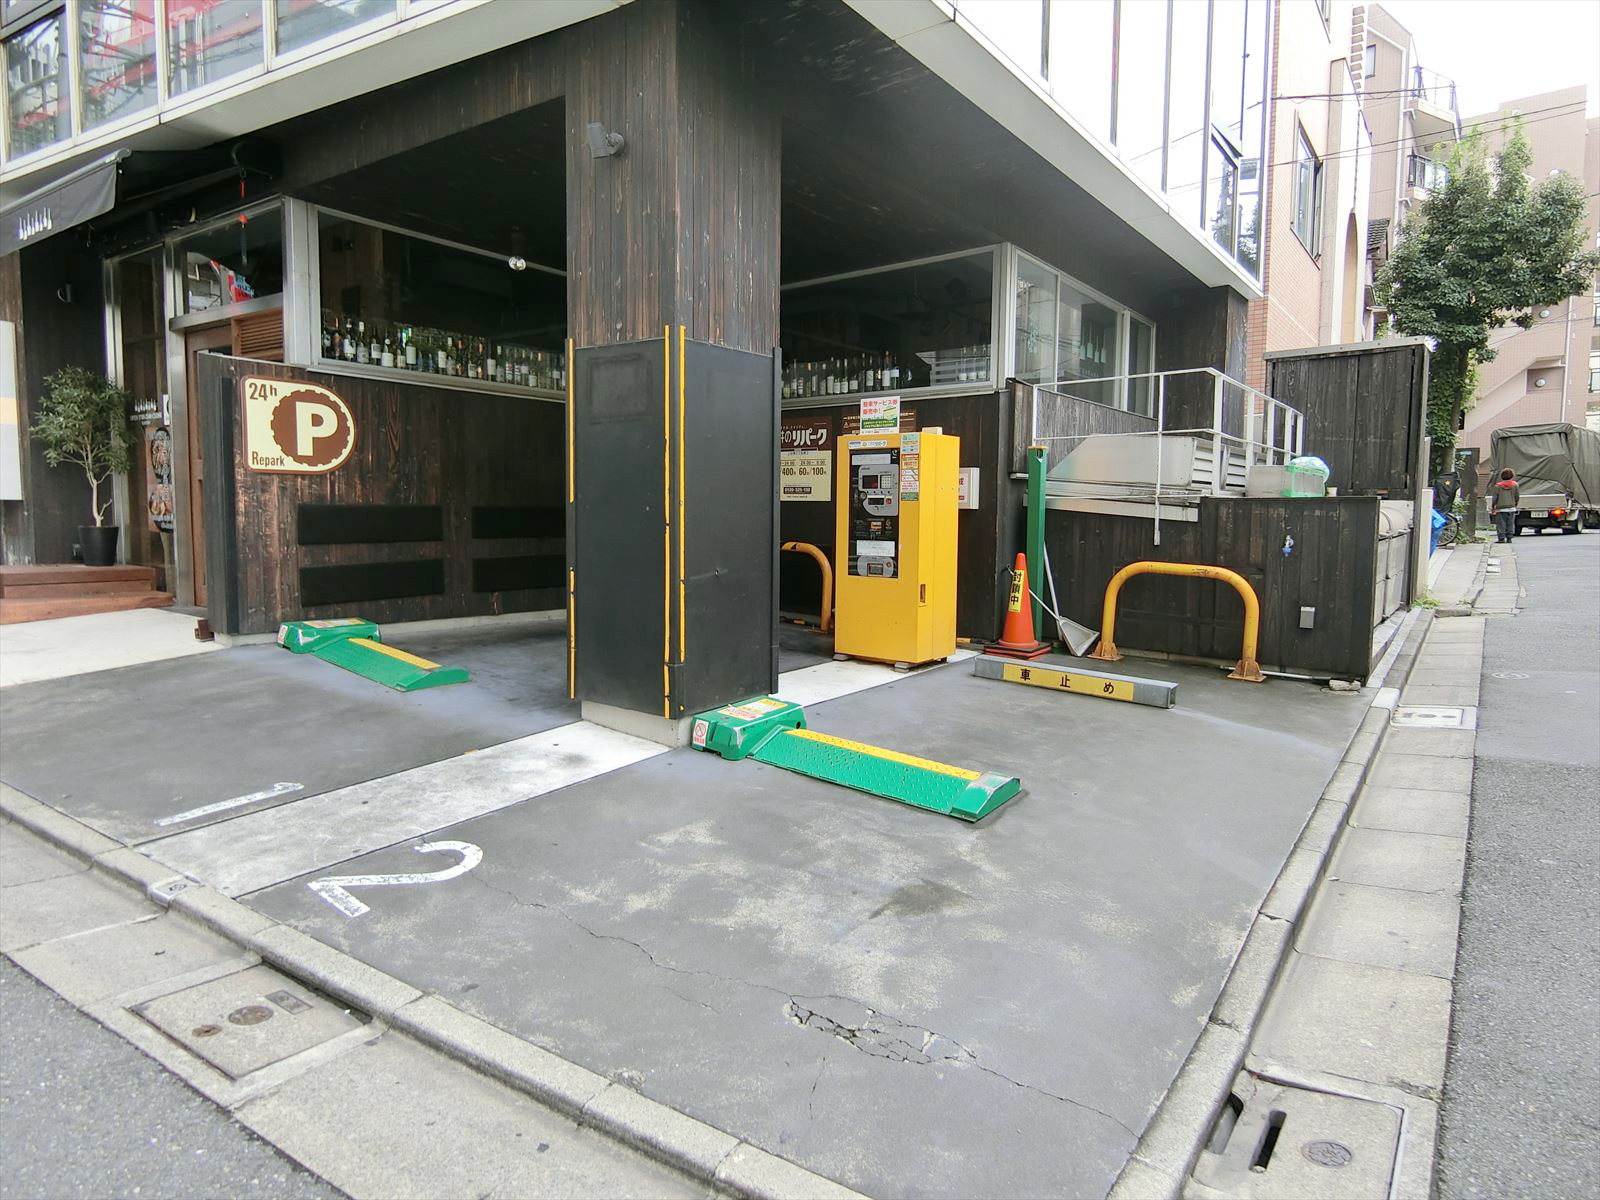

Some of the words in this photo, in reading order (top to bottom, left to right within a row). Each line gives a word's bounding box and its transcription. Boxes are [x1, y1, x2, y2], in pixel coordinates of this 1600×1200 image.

[249, 383, 277, 400] 24h
[296, 402, 338, 456] P
[252, 451, 285, 467] Repark
[1020, 668, 1114, 694] 車止め
[307, 840, 483, 917] 2
